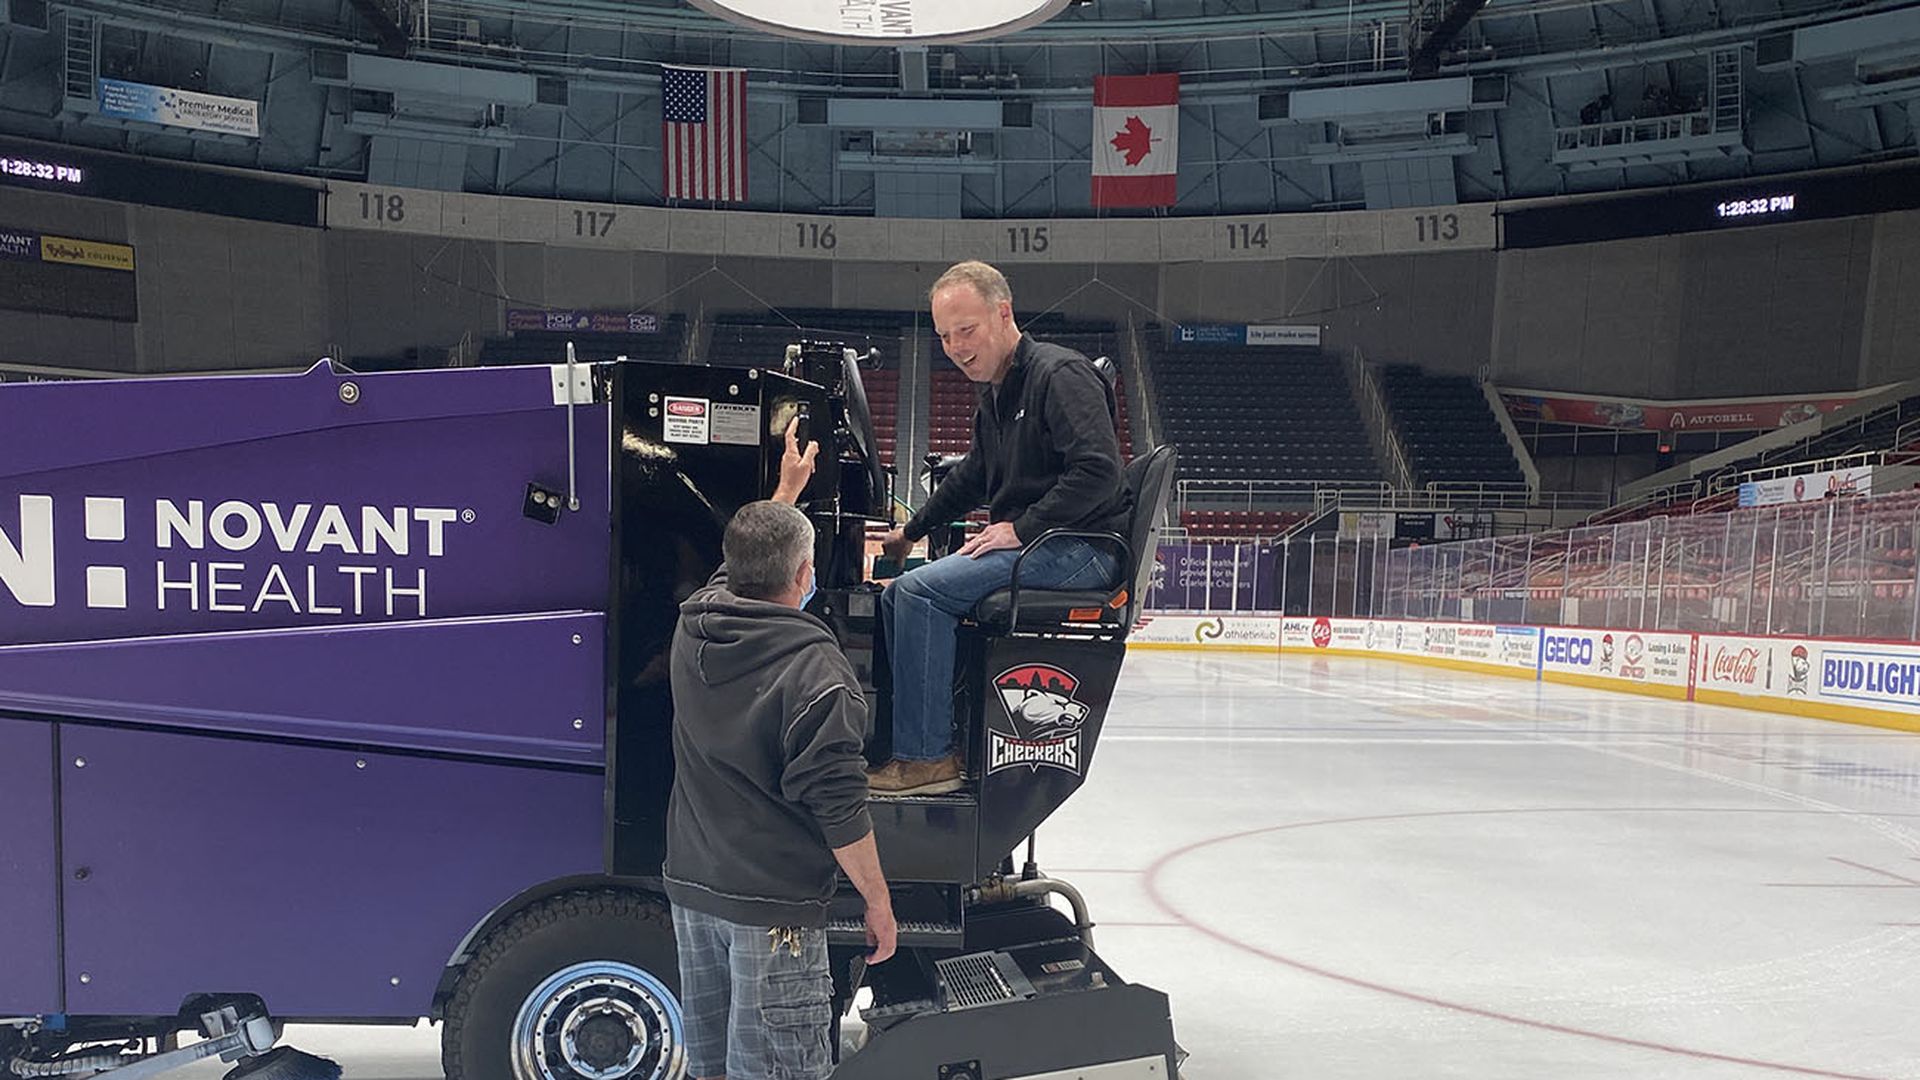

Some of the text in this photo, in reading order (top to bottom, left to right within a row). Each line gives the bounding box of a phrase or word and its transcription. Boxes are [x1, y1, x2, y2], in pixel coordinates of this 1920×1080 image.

[178, 98, 254, 117] Premier Medical
[0, 158, 81, 183] 1:28:32 PM
[358, 191, 405, 222] 118
[1717, 195, 1795, 217] 1:28:32 PM
[573, 210, 617, 238] 117
[796, 222, 838, 250] 116
[1227, 222, 1269, 249] 114
[1415, 213, 1459, 242] 113
[1007, 227, 1050, 253] 115
[547, 313, 573, 324] POP
[1689, 413, 1754, 425] AUTOBELL
[1180, 568, 1211, 577] provide
[156, 560, 427, 617] HEALTH
[1545, 635, 1593, 666] GEICO
[1823, 658, 1866, 690] BUD
[991, 734, 1077, 769] CHECKERS
